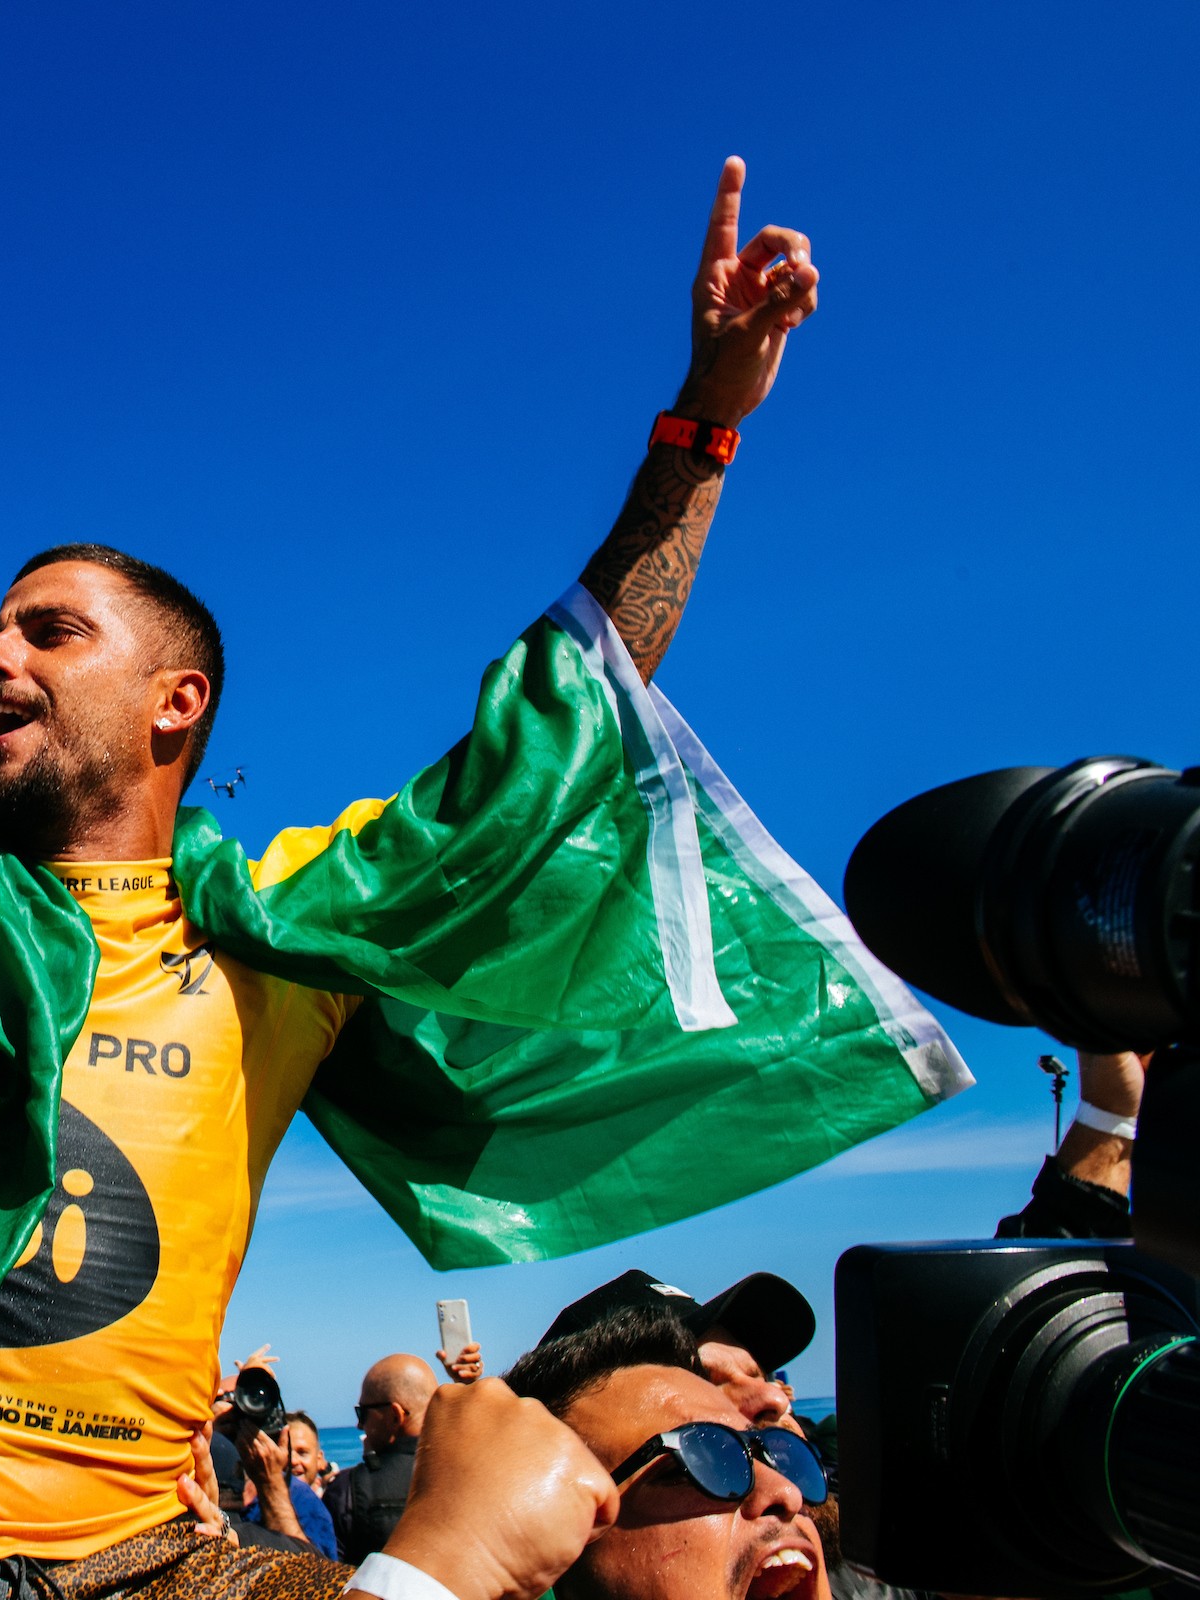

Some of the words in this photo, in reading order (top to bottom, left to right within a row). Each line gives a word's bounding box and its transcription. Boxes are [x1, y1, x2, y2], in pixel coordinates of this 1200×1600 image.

[98, 875, 154, 891] LEAGUE
[88, 1032, 191, 1079] PRO
[24, 1413, 53, 1431] DE
[58, 1420, 143, 1442] JANEIRO
[66, 1408, 85, 1419] DO
[93, 1413, 145, 1427] ESTADO
